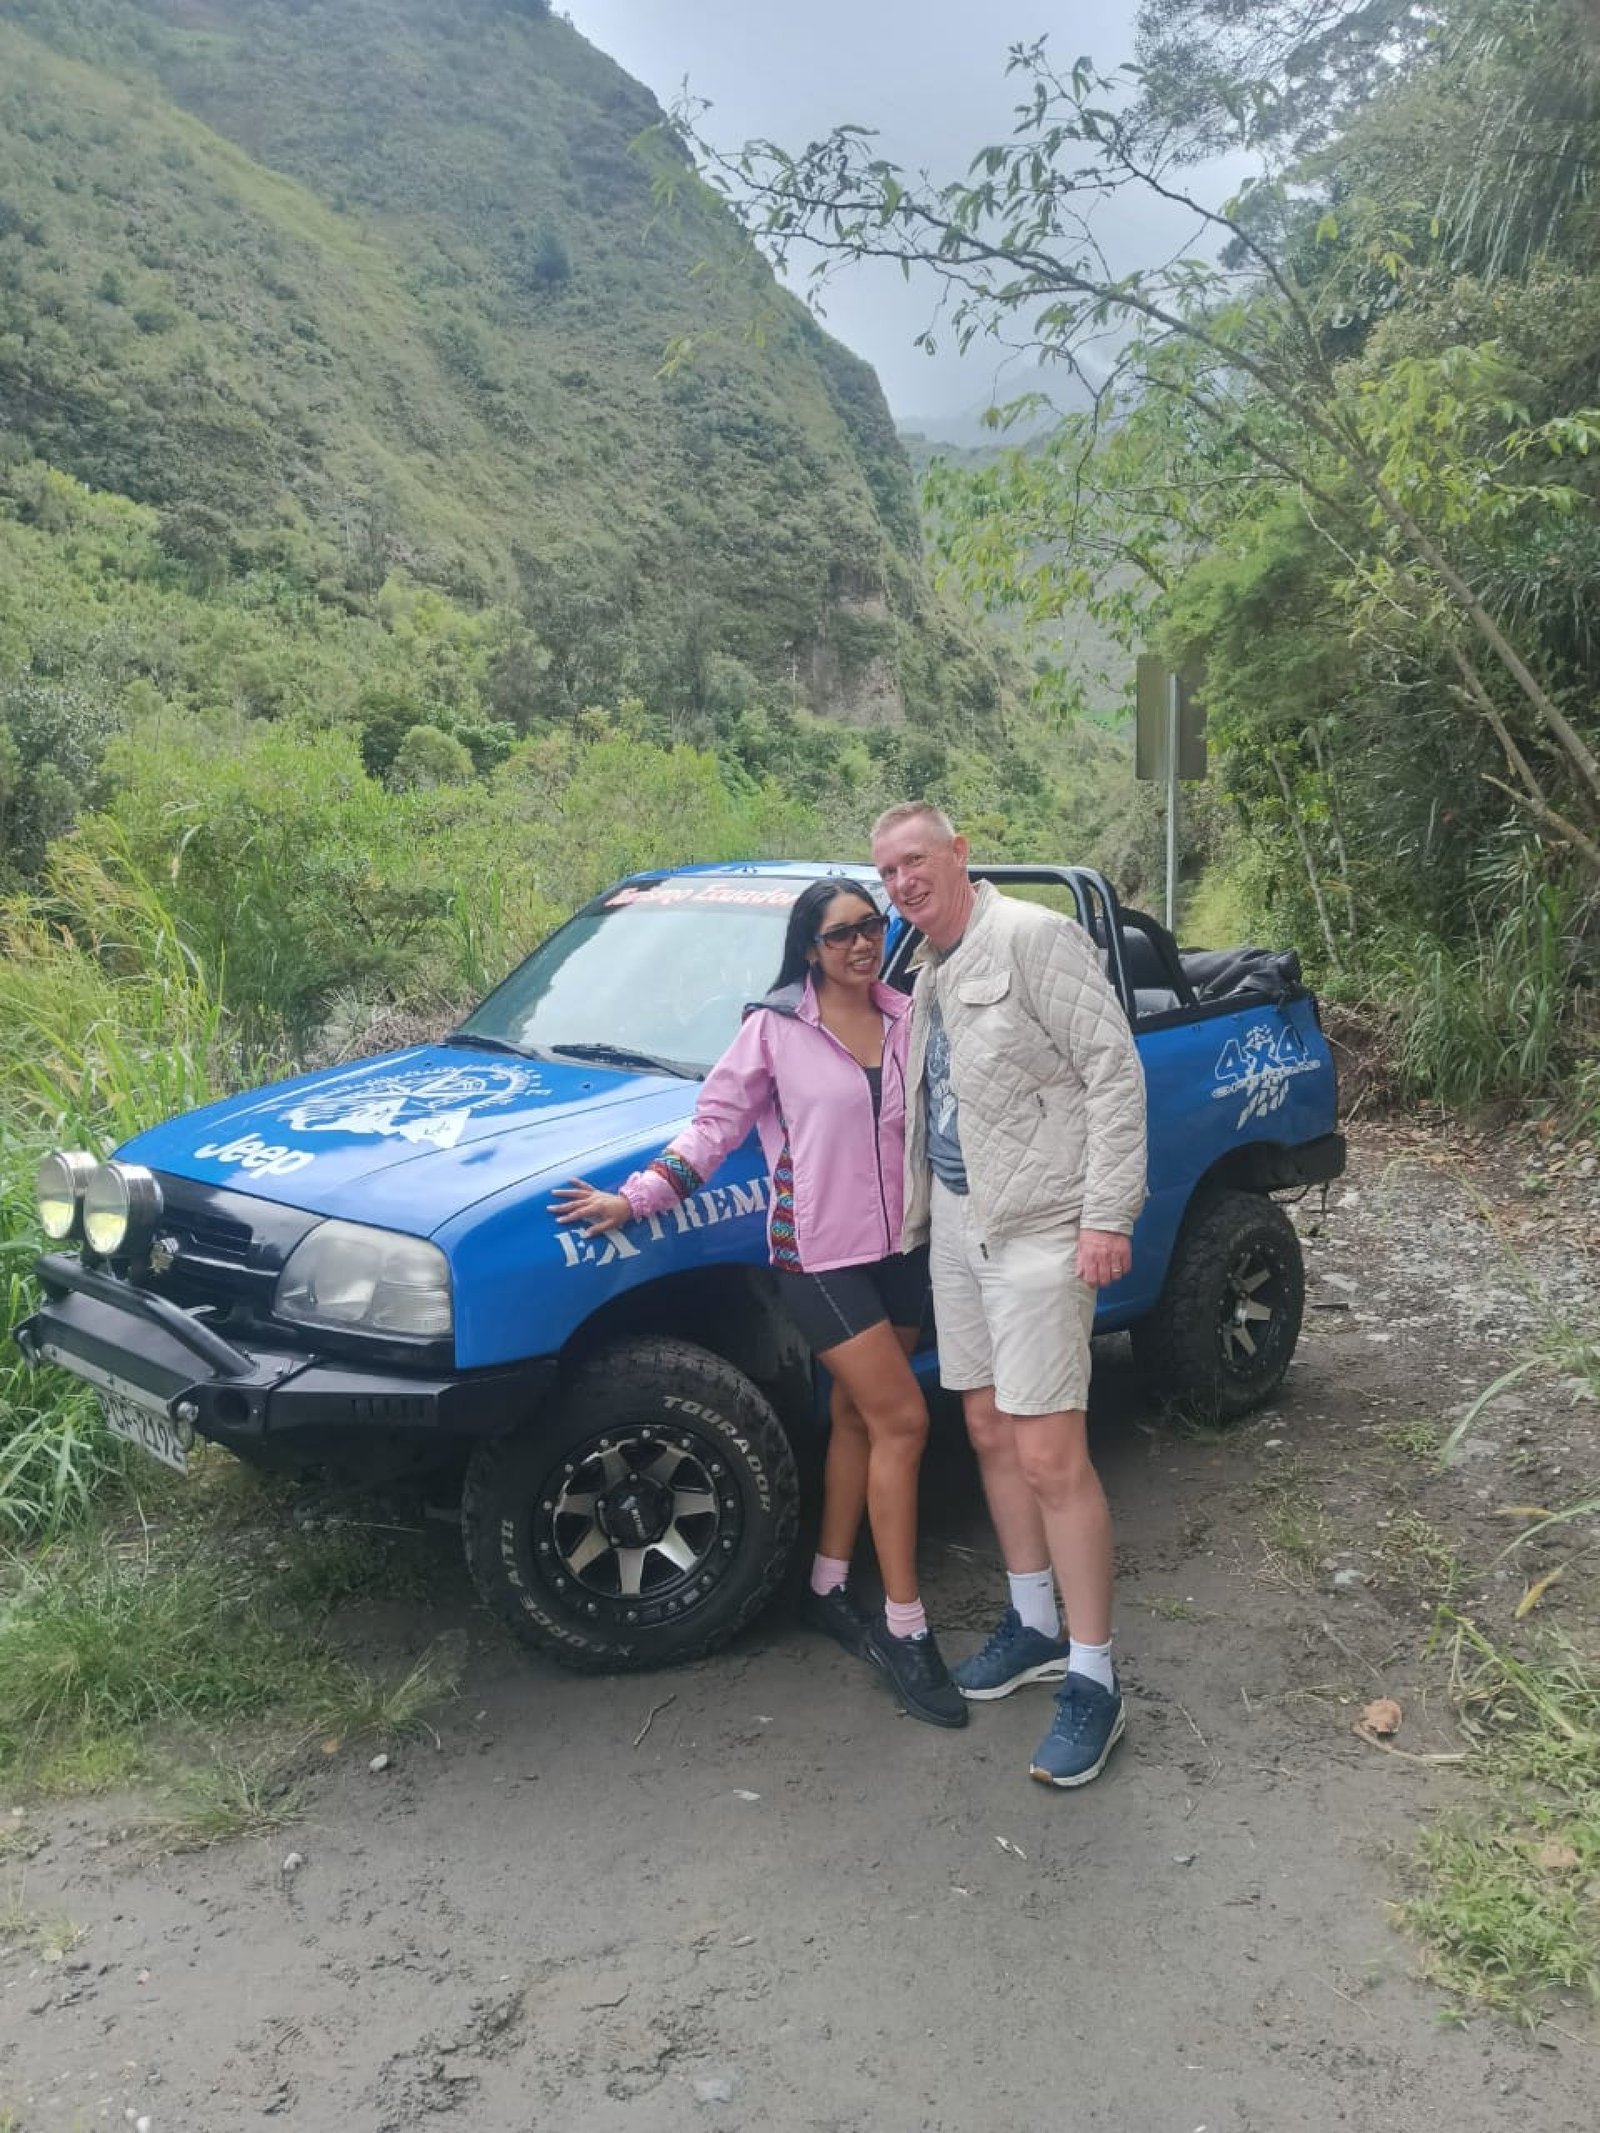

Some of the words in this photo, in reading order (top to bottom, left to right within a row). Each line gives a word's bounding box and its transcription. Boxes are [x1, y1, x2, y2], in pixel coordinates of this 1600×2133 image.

[193, 1132, 316, 1179] Jeep
[552, 1175, 773, 1268] EXTREM
[661, 1395, 773, 1513] TOURADOR
